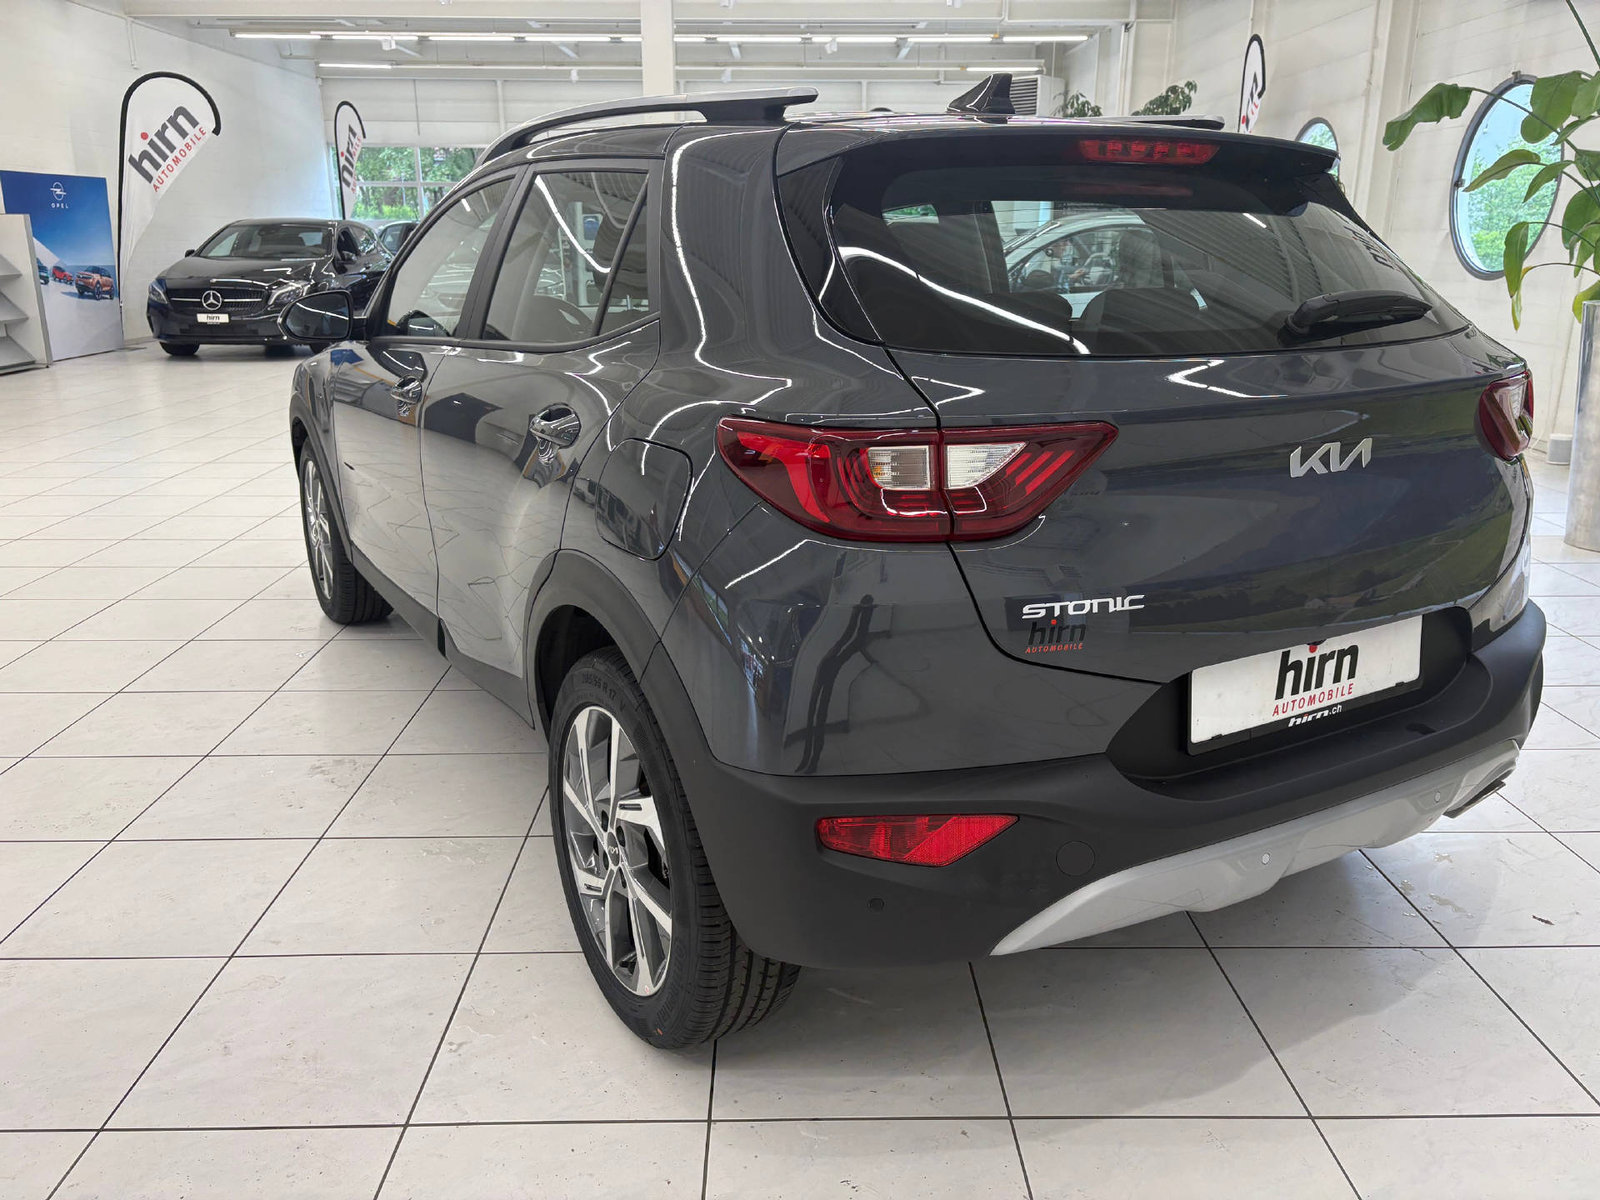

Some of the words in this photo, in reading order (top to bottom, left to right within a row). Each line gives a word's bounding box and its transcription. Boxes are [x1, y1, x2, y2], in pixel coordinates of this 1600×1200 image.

[128, 106, 199, 184] hirn
[153, 126, 206, 192] AUTOMOBILE
[1290, 438, 1373, 478] KIA
[1021, 594, 1145, 619] STONIC
[1025, 642, 1084, 654] AUTOMOBILE
[1028, 619, 1087, 646] hirn
[1274, 644, 1359, 701] hirn
[1272, 682, 1355, 717] AUTOMOBILE
[1288, 704, 1342, 728] hirn.ch
